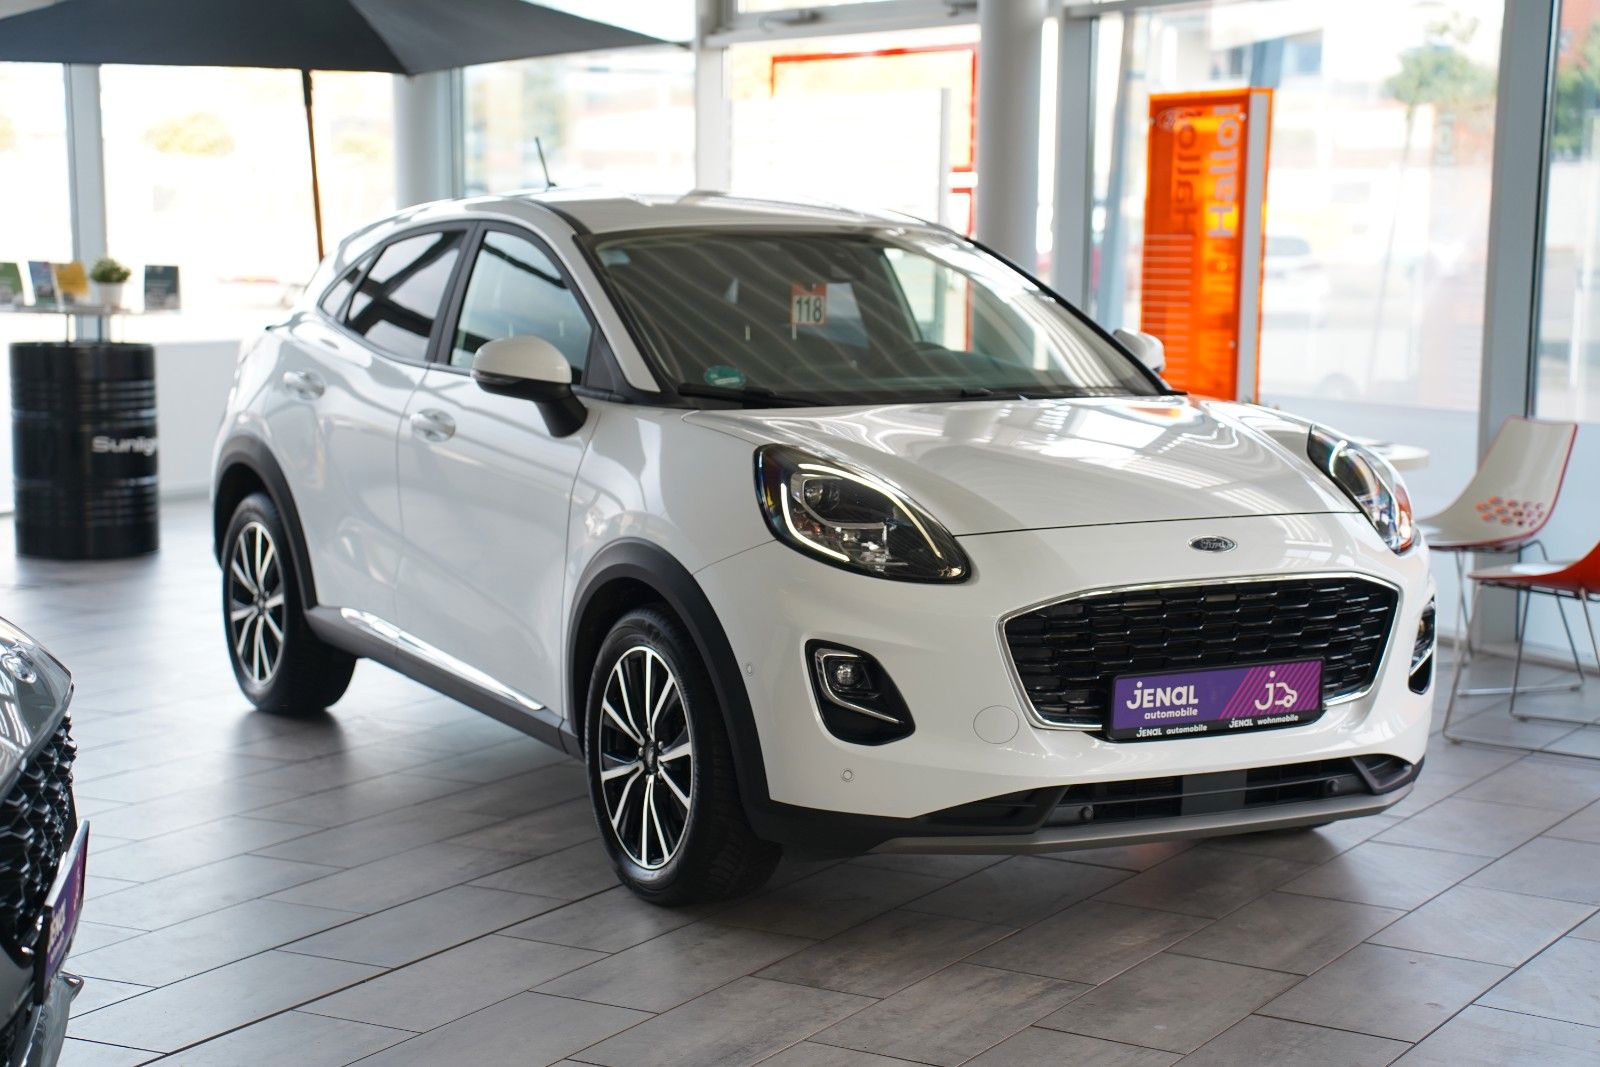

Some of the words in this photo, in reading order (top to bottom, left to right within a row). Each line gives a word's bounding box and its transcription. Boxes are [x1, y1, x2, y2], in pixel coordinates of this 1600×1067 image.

[796, 298, 822, 322] 118
[92, 435, 158, 457] Sunlig
[1145, 708, 1198, 720] automobile
[1257, 714, 1298, 725] wohnmobile
[1166, 725, 1207, 735] automobile
